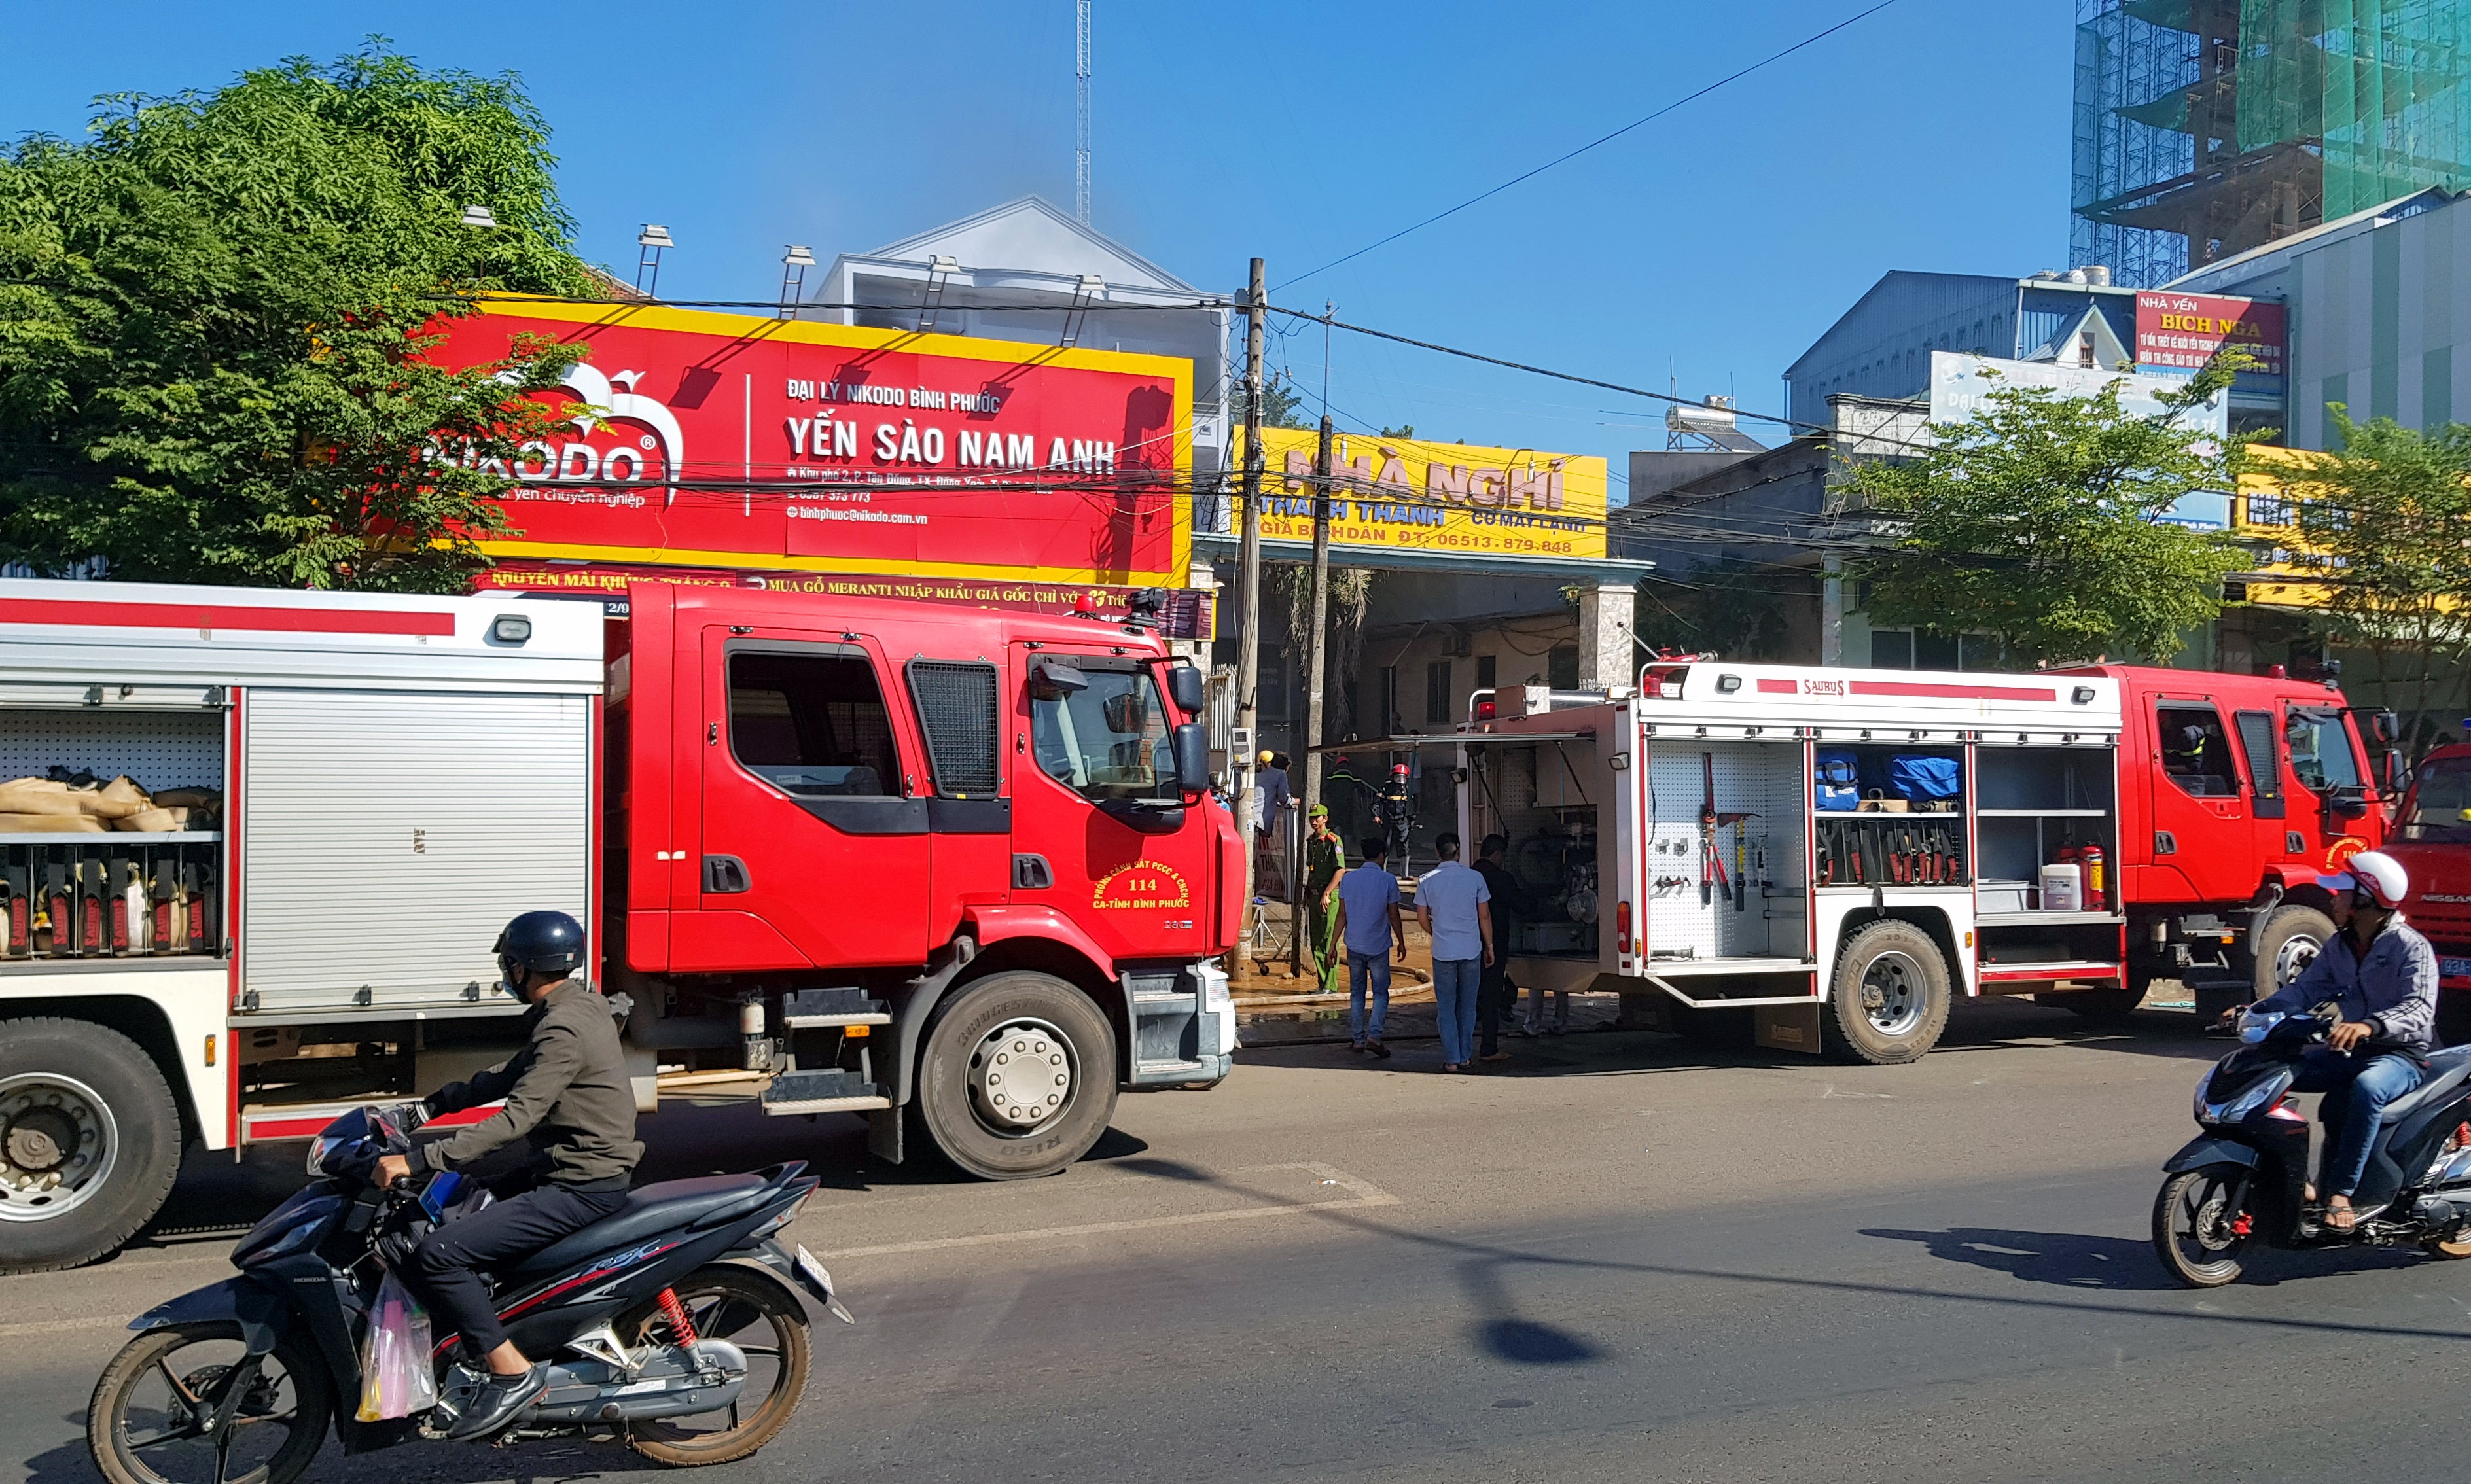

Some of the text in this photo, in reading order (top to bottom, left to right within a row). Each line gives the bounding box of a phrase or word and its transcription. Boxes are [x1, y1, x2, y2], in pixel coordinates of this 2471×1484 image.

[2140, 296, 2197, 312] NHÀ YẾN
[2161, 311, 2262, 338] BÍCH NGA
[787, 379, 1001, 414] ĐẠI LÝ NIKODO BÌNH PHƯỚC
[786, 409, 1114, 476] YẾN SÀO NAM ANH
[799, 467, 818, 479] Khu
[1285, 446, 1567, 510] NHÀ NGHỈ
[1260, 497, 1348, 519] THAH
[1347, 525, 1386, 540] DÂN
[768, 579, 800, 593] MUA
[803, 576, 825, 593] GỖ
[828, 582, 891, 596] MERANTI
[895, 583, 933, 601] NHẬP
[936, 582, 973, 600] KHẨU
[976, 587, 1000, 601] GIÁ
[1003, 586, 1031, 603] GỐC
[1034, 588, 1057, 603] CHỈ
[1060, 590, 1082, 605] VỚ
[1804, 679, 1845, 696] SAURUS
[1093, 874, 1113, 900] PHÒNG
[1109, 862, 1132, 877] CẢNH
[1133, 858, 1150, 869] SÁT
[1151, 861, 1173, 875] PCCC
[1176, 878, 1190, 898] CNCH
[1129, 879, 1158, 891] 114
[1093, 897, 1190, 909] CA-TỈNH BÌNH PHƯỚC
